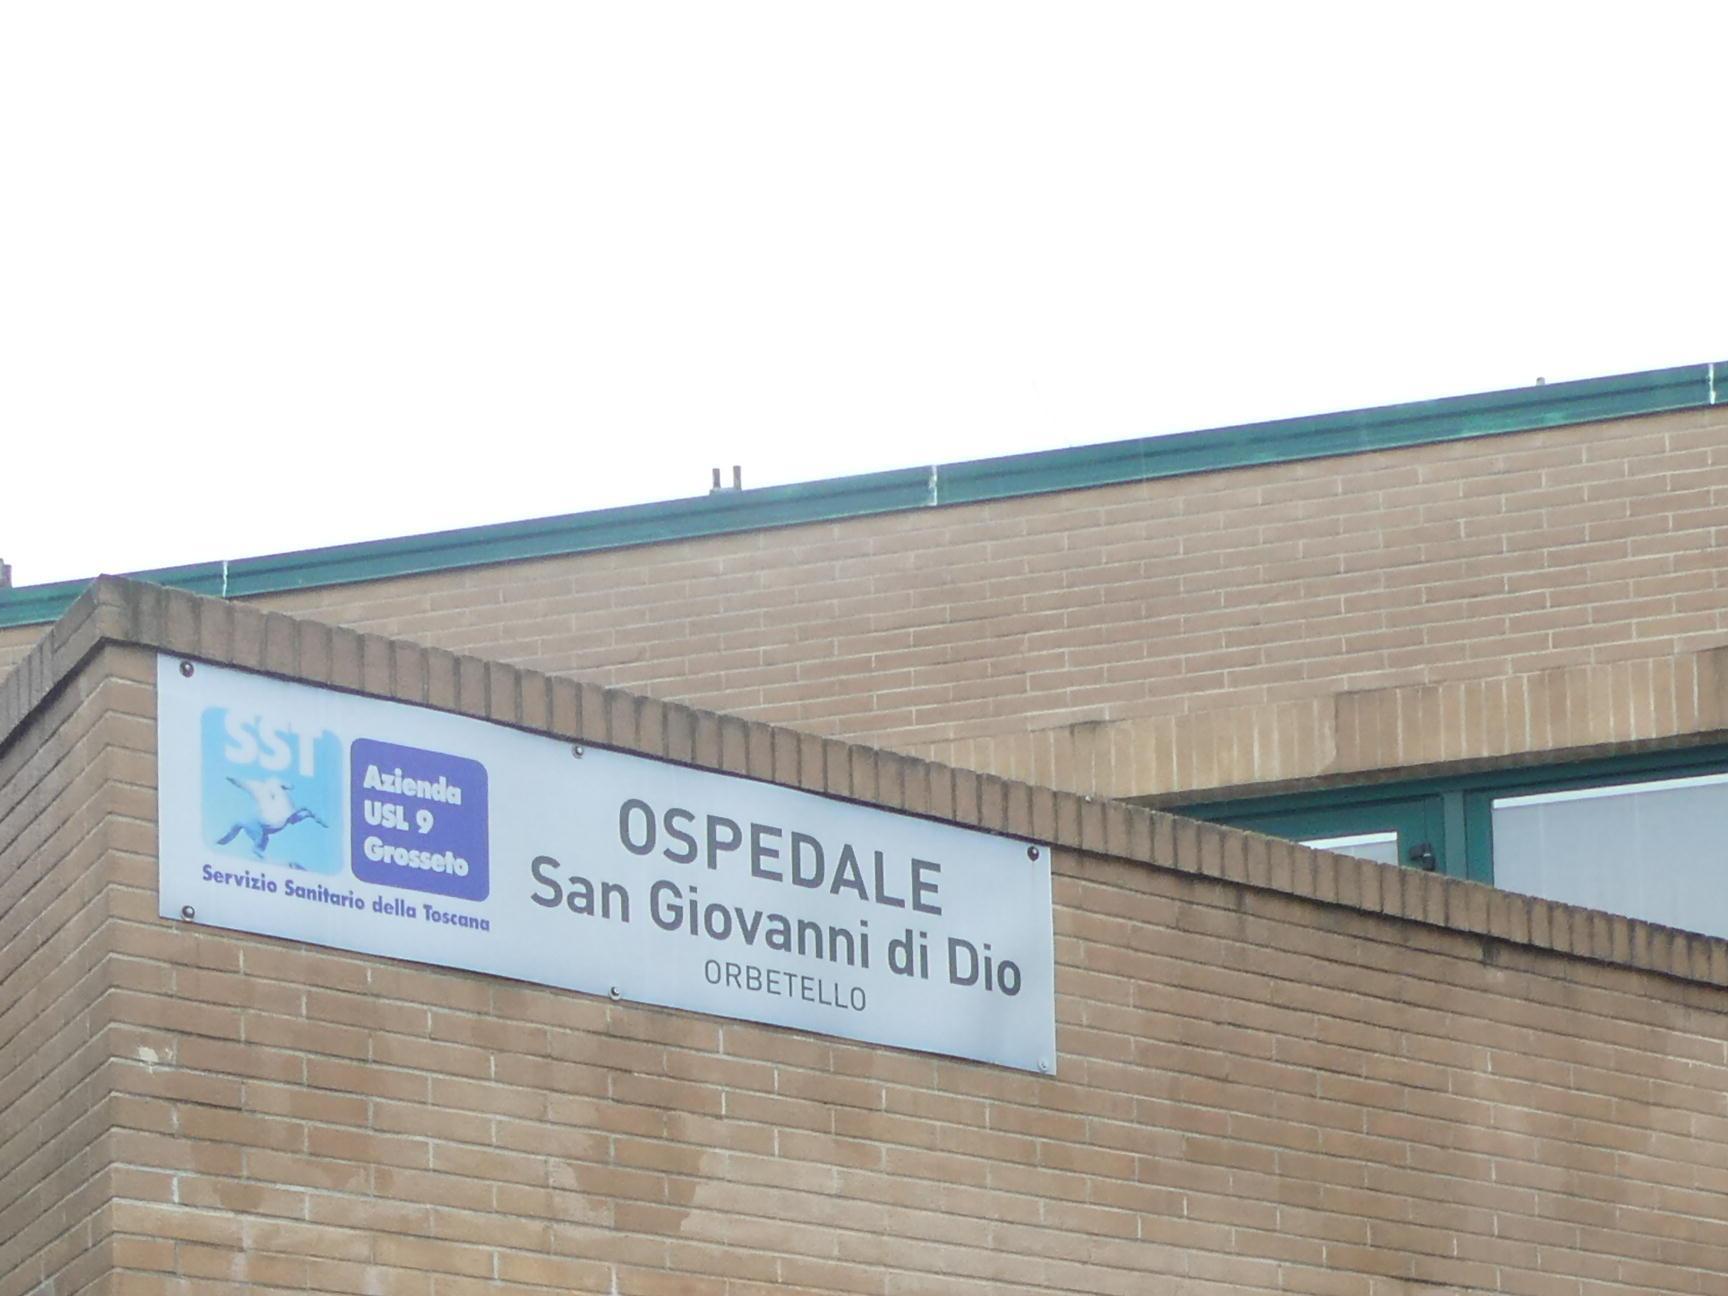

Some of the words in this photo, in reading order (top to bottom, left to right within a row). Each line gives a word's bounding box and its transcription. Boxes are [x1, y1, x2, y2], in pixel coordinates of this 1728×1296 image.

[223, 704, 322, 778] SST
[363, 764, 462, 806] Azienda
[363, 800, 410, 833] USL
[415, 808, 435, 835] 9
[363, 836, 470, 878] Grosseto
[618, 798, 943, 917] OSPEDALE
[202, 864, 278, 894] Servizio
[284, 879, 366, 910] Sanitario
[371, 895, 417, 919] della
[423, 903, 491, 932] Toscana
[530, 855, 631, 924] San
[649, 879, 869, 969] Giovanni
[887, 929, 929, 980] di
[947, 936, 1023, 997] Dio
[704, 958, 867, 1012] ORBETELLO
